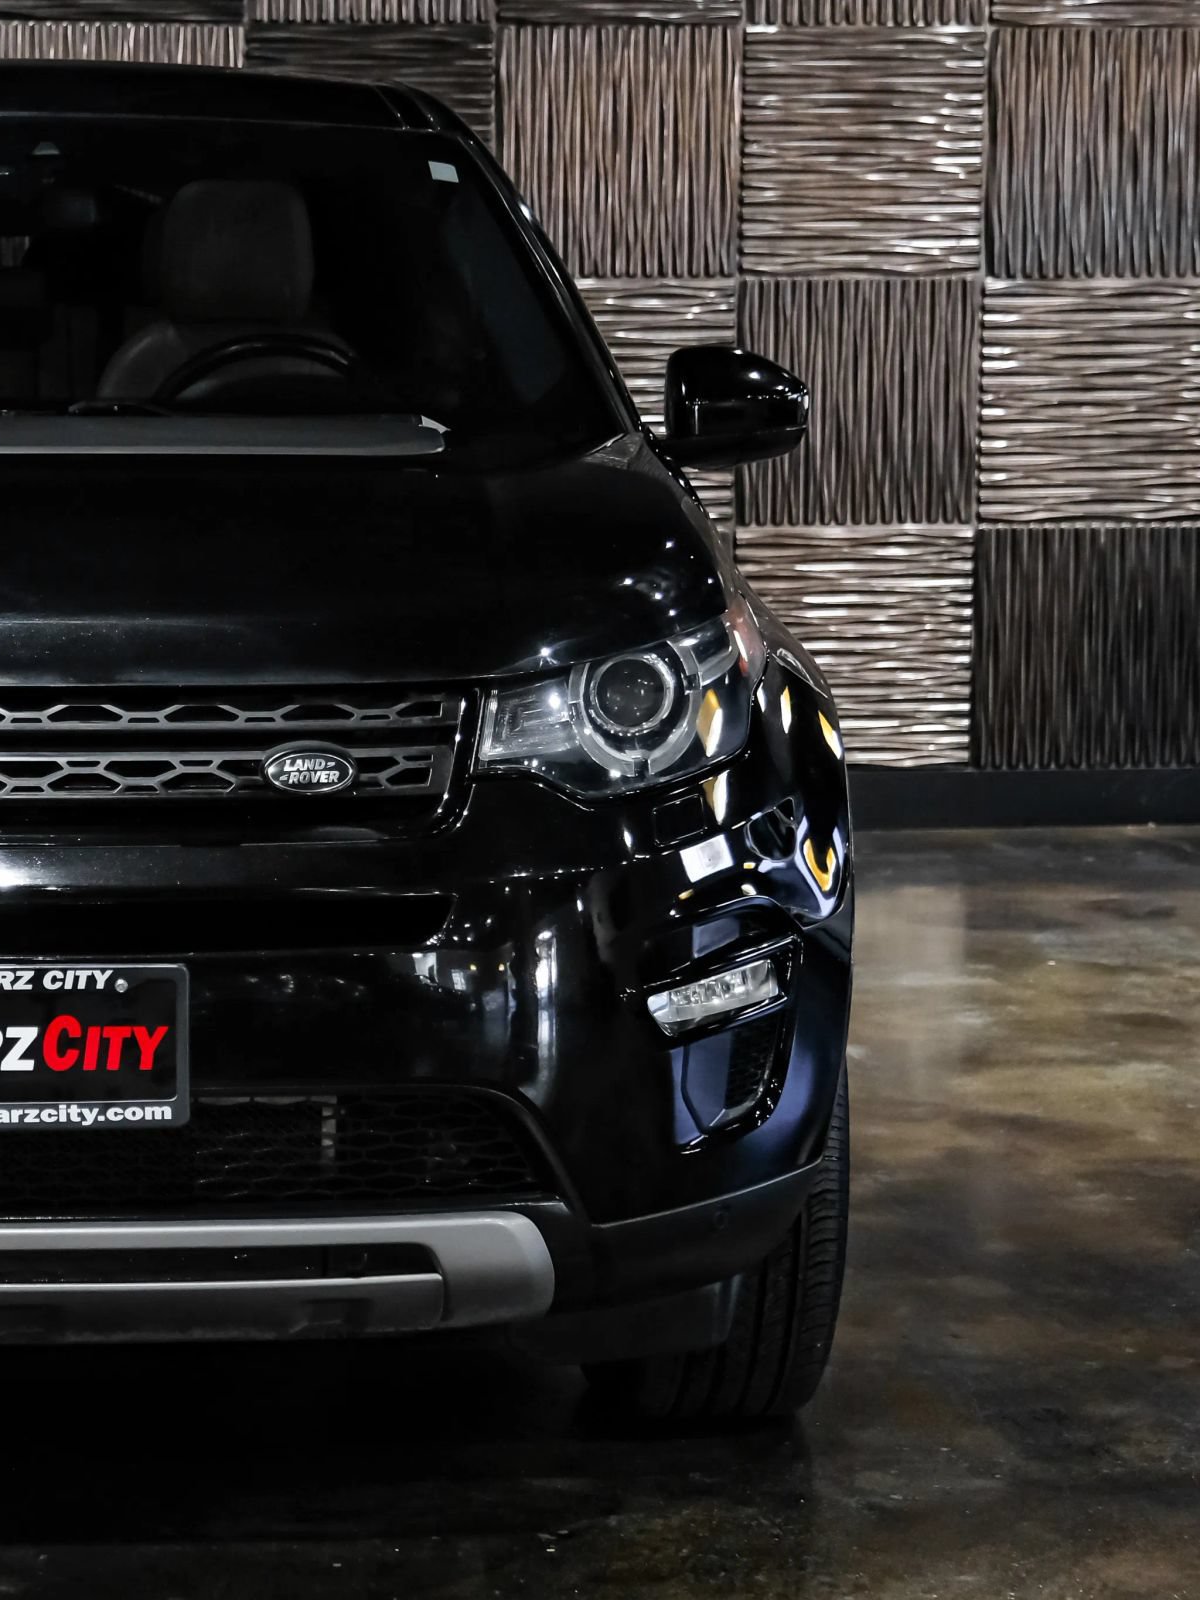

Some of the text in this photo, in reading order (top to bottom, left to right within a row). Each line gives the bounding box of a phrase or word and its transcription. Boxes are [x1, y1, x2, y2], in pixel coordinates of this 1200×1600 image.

[283, 759, 326, 771] LAND
[288, 771, 340, 784] ROVER
[42, 970, 114, 990] CITY
